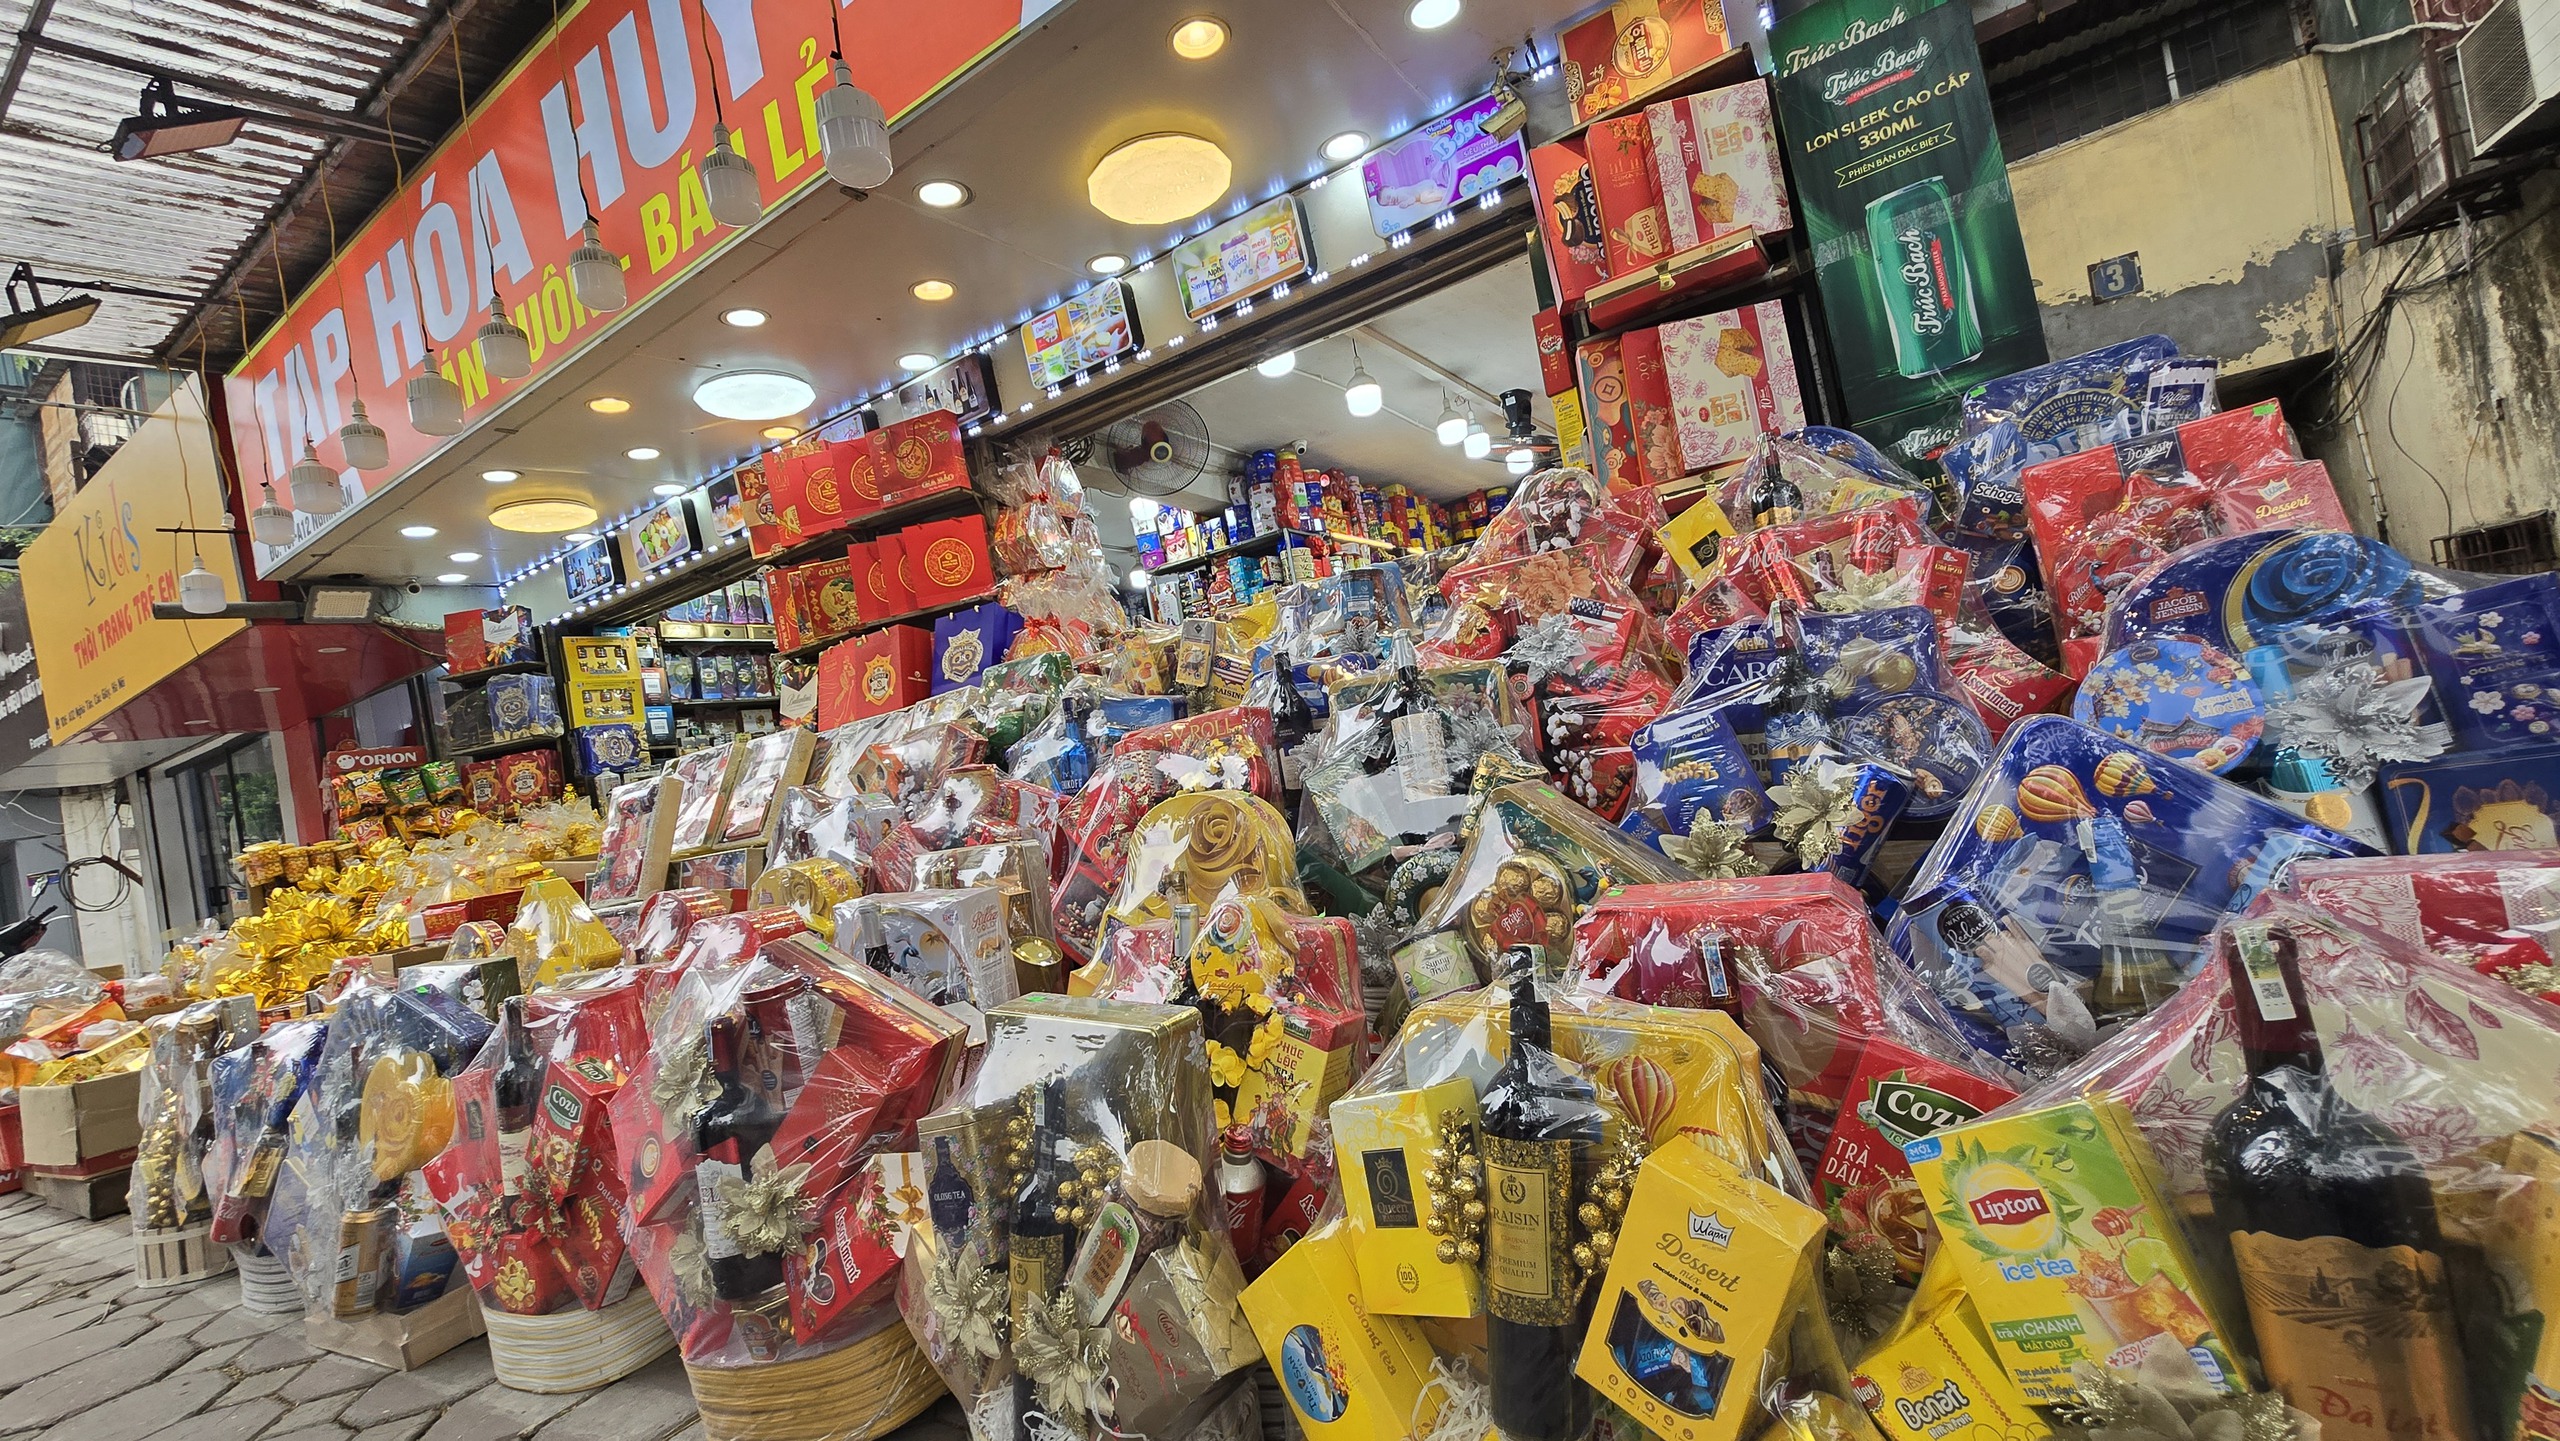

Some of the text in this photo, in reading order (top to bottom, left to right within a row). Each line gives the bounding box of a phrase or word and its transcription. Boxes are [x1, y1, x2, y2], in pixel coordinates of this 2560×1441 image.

[1783, 42, 1835, 78] Trúc
[1824, 38, 1930, 100] Trúc Bạch
[1805, 72, 1972, 153] LON SLEEK CAO CẤP
[1858, 115, 1922, 150] 330ML
[1848, 135, 1940, 179] PHIÊN BẢN ĐẶC BIỆT
[1639, 215, 1660, 250] MERRY
[365, 149, 534, 388] HÓA
[1897, 227, 1942, 334] Trúc Bạch
[2108, 263, 2125, 292] 3
[2256, 494, 2312, 520] Dessert
[74, 480, 141, 607] Kids
[97, 603, 133, 656] TRANG
[158, 569, 177, 603] EM
[2154, 603, 2203, 620] JENSEN
[2157, 594, 2198, 610] JACOB
[2468, 658, 2527, 676] OOLONG
[1959, 668, 2024, 720] Assortment
[359, 751, 418, 767] ORION
[551, 1089, 579, 1118] Cozy
[1836, 1135, 1871, 1168] TRÀ
[1908, 1143, 1932, 1157] MỚI
[595, 1180, 614, 1201] Date
[952, 1189, 966, 1200] TEA
[1376, 1203, 1410, 1216] Queen
[1493, 1206, 1541, 1227] RAISIN
[1975, 1195, 2042, 1221] Lipton
[833, 1205, 864, 1285] Assortment
[1498, 1256, 1538, 1270] PREMIUM
[1499, 1266, 1537, 1280] QUALITY
[1655, 1232, 1741, 1293] Dessert
[1679, 1268, 1702, 1286] mix
[1998, 1255, 2078, 1283] ice tea
[1652, 1262, 1729, 1313] Chocolate taste & Milk taste
[1158, 1311, 1178, 1346] Vobro
[1347, 1292, 1397, 1377] Oolong tea
[1996, 1326, 2014, 1340] trà
[2024, 1317, 2081, 1336] CHANH
[2021, 1337, 2070, 1352] MẬT ONG
[1894, 1379, 1970, 1431] Bonart
[2022, 1385, 2047, 1398] 192g
